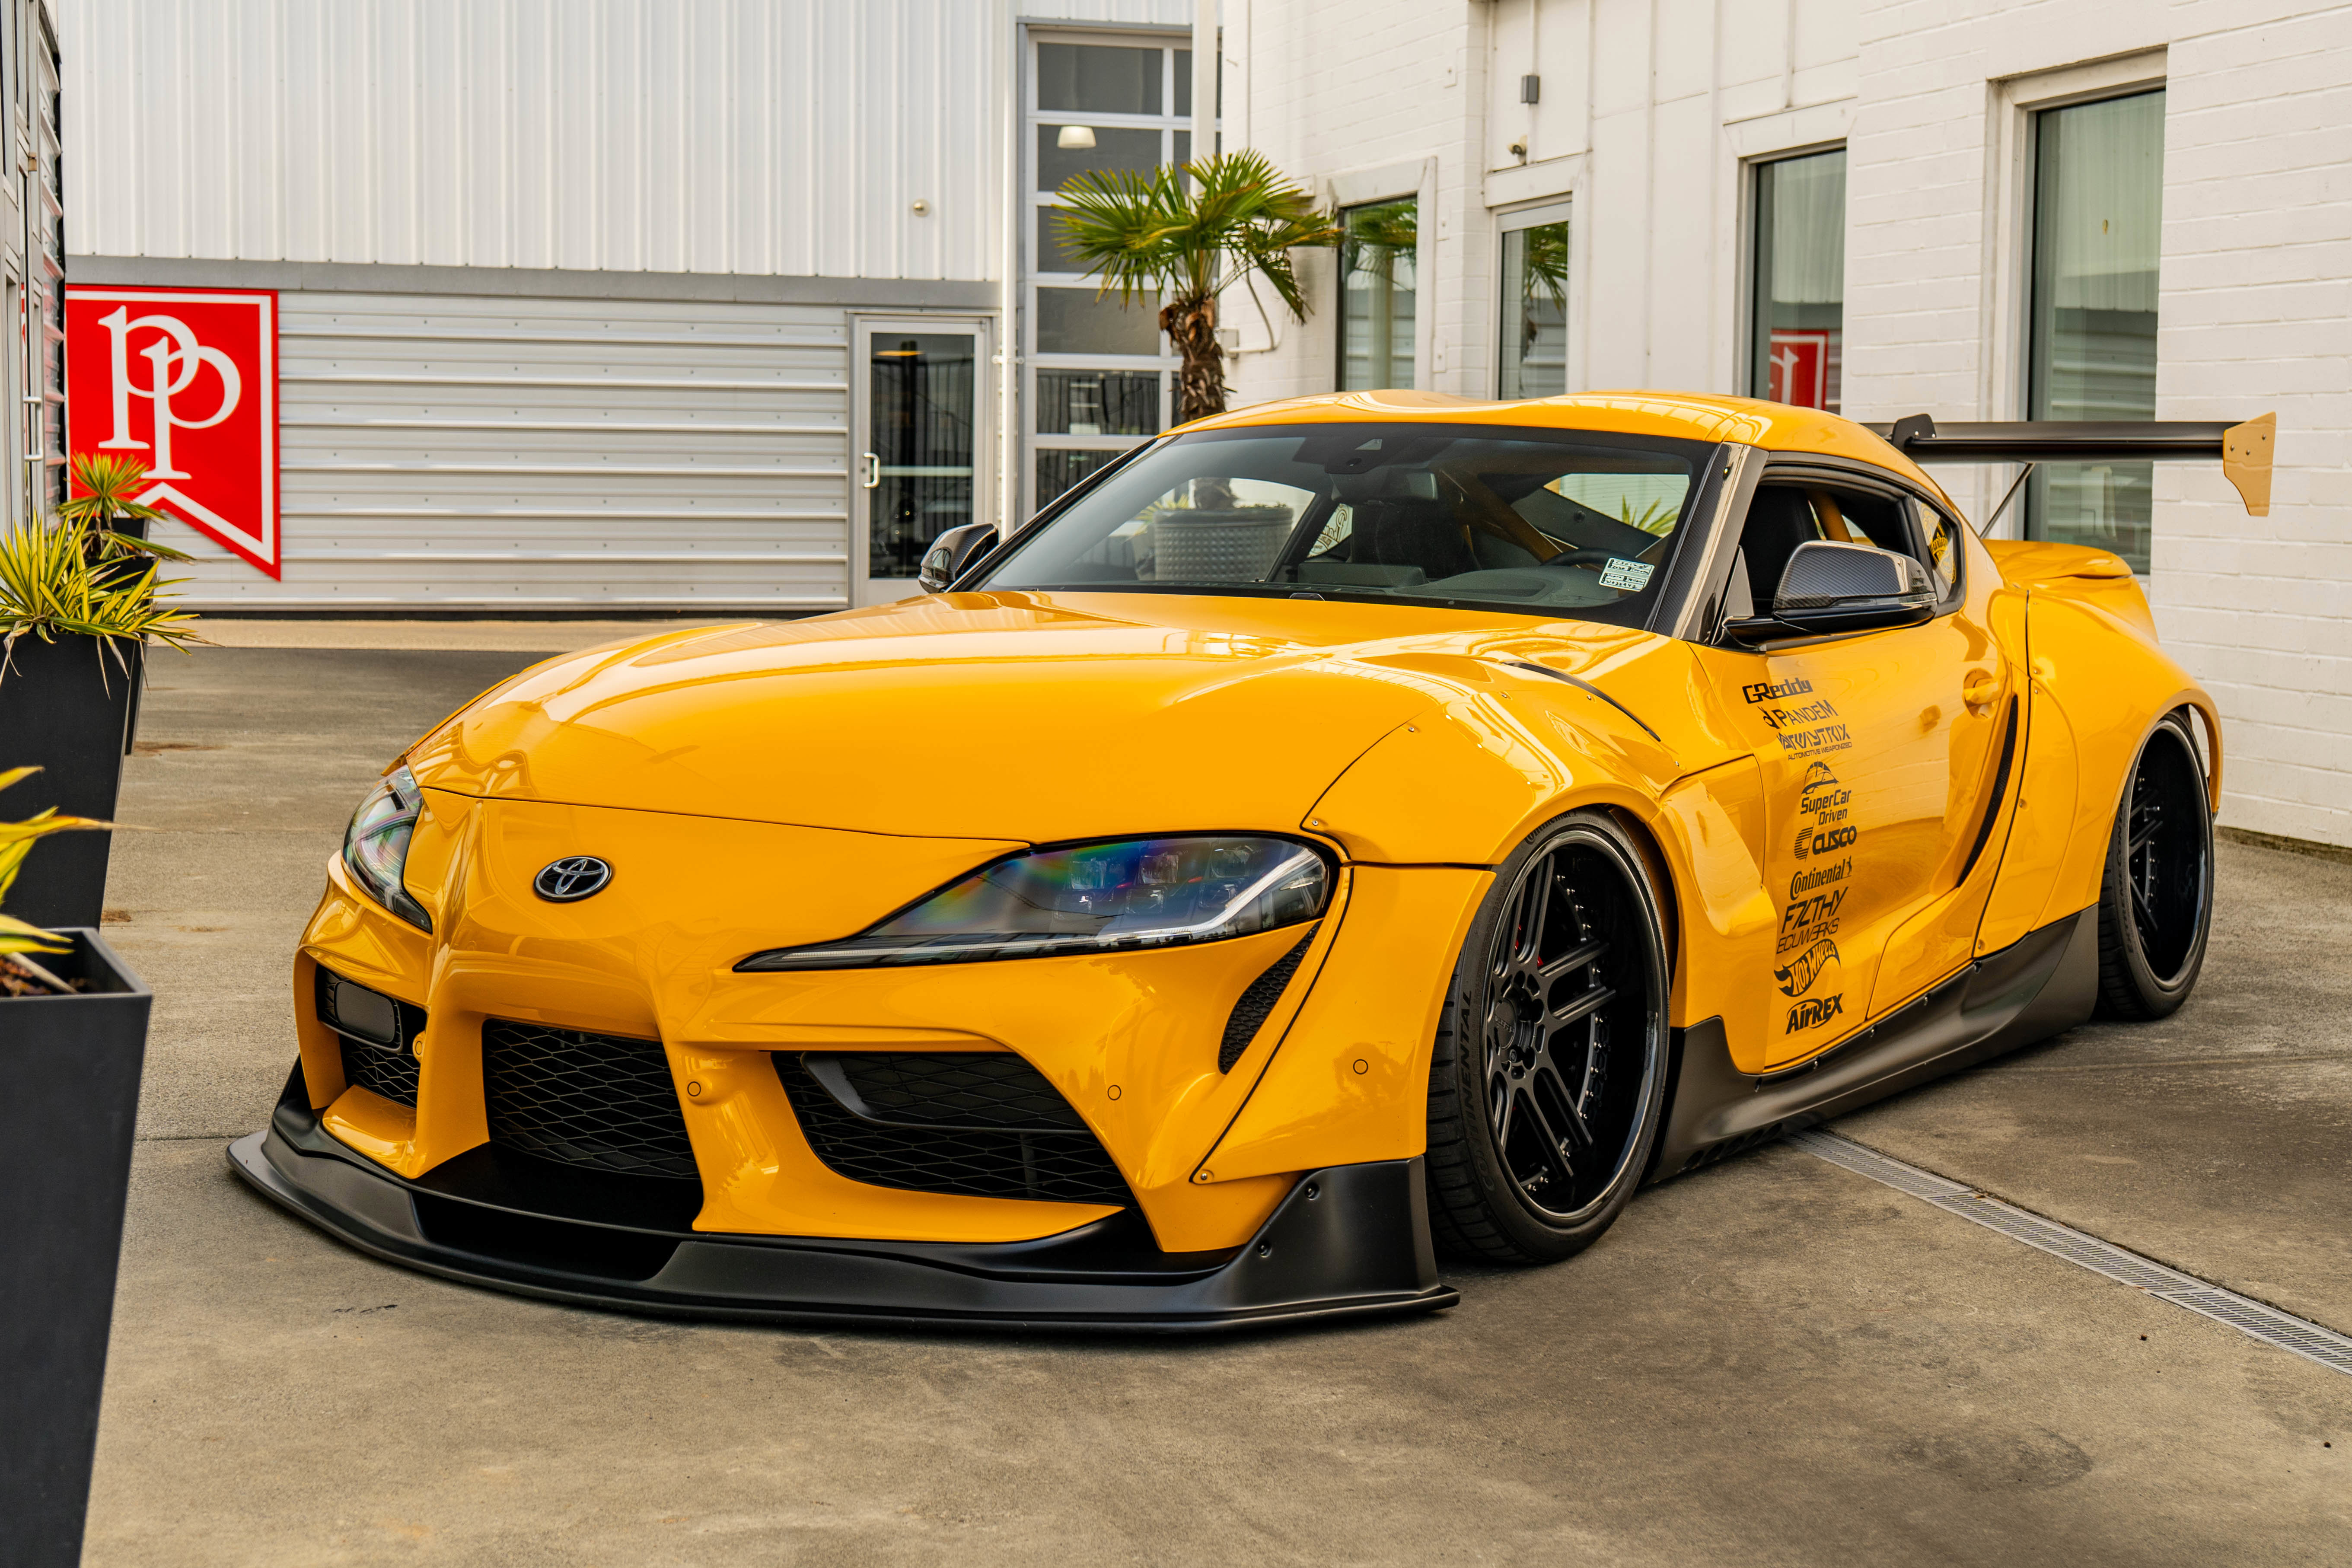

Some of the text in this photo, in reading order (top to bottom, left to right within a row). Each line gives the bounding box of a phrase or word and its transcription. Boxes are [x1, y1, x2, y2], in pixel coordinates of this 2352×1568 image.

[1742, 677, 1813, 704] GReddy
[1772, 699, 1839, 727] PANDEM
[1788, 742, 1852, 761] AUTOMOTIVE WEAPONIZED
[1801, 789, 1851, 815] SuperCar
[1818, 808, 1848, 825] Driven
[1812, 825, 1857, 855] CUSCO
[1790, 858, 1846, 901] Continental
